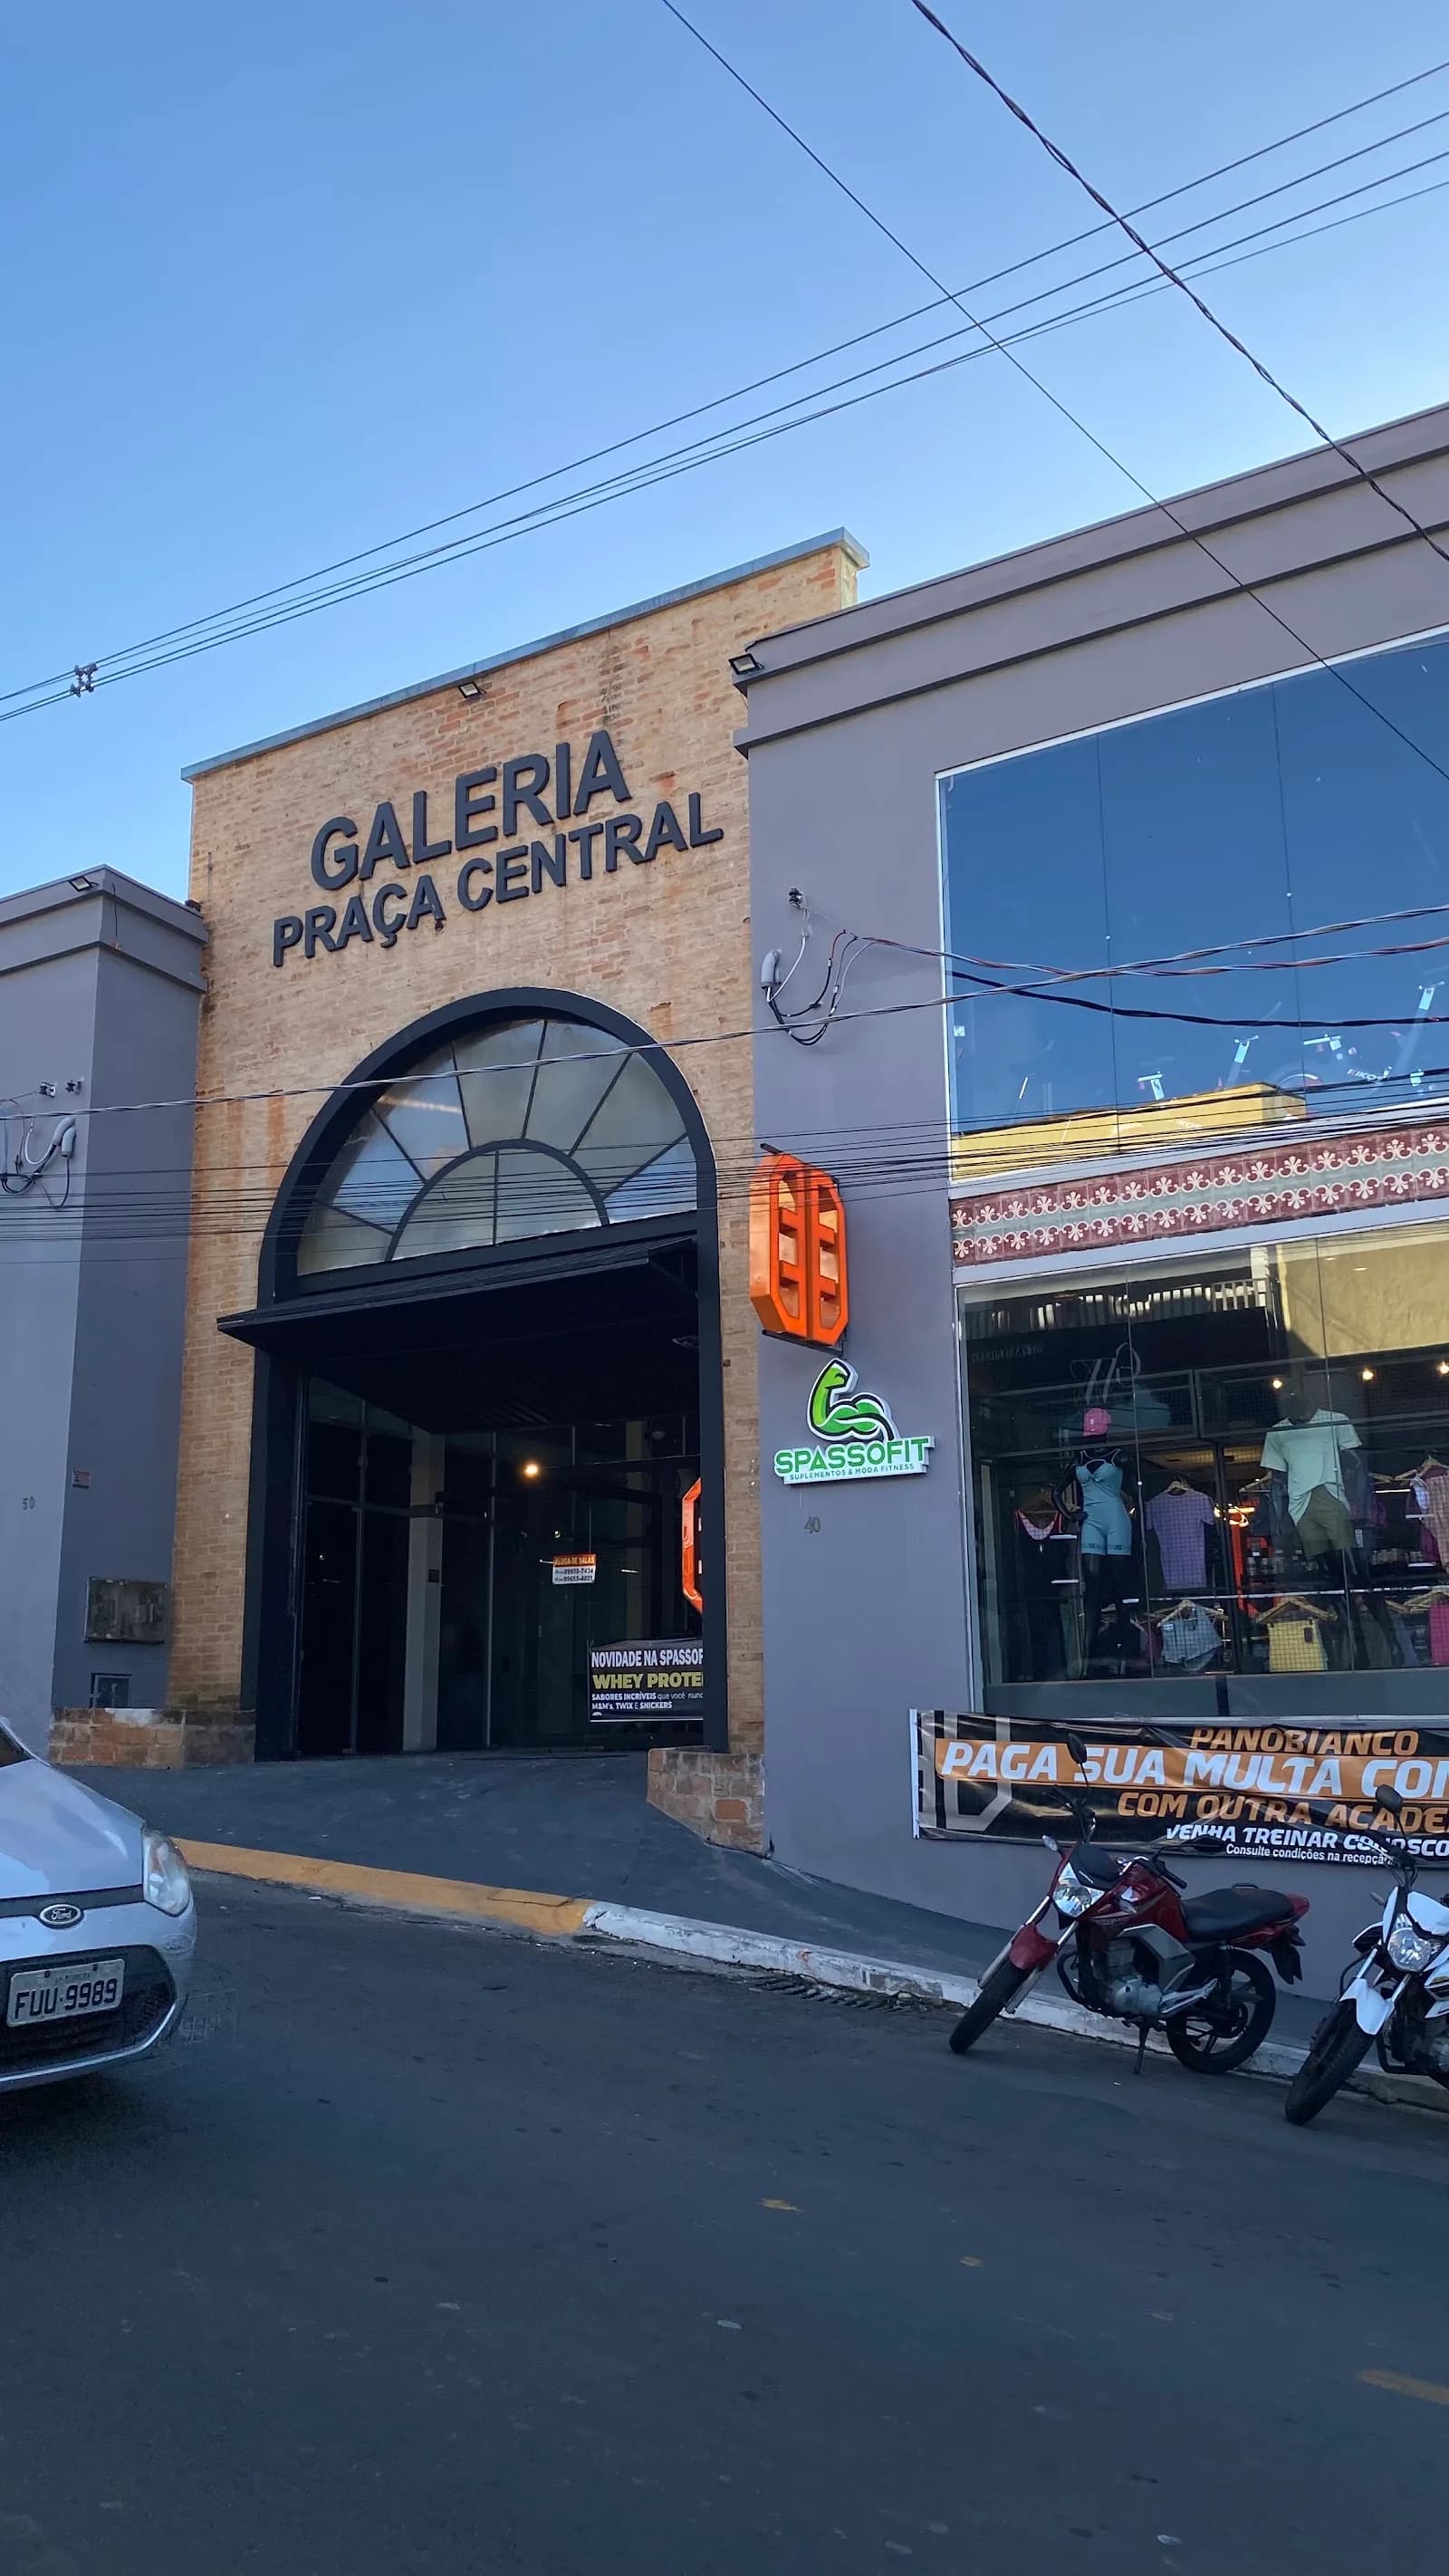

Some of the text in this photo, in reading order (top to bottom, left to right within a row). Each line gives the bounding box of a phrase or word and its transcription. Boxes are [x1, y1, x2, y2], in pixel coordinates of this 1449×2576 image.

[310, 729, 632, 890] GALERIA
[273, 792, 724, 967] PRAÇA CENTRAL
[775, 1437, 929, 1475] SPASSOFIT
[790, 1469, 846, 1481] SUPLEMENTOS
[855, 1466, 878, 1475] MODA
[881, 1463, 914, 1473] FITNESS
[22, 1496, 35, 1511] 50
[804, 1516, 820, 1533] 40
[591, 1650, 642, 1668] NOVIDADE
[644, 1649, 657, 1667] NA
[592, 1671, 703, 1689] WHEY PROTE
[591, 1692, 623, 1701] SABORES
[623, 1690, 657, 1701] INCRÍVEIS
[657, 1692, 670, 1701] que
[670, 1691, 686, 1700] você
[616, 1702, 634, 1710] TWIX
[635, 1702, 638, 1710] E
[639, 1701, 673, 1710] SNICKERS
[1189, 1725, 1420, 1756] PANOBIANCO
[939, 1741, 1058, 1781] PAGA
[1074, 1745, 1166, 1784] SUA
[1184, 1751, 1342, 1795] MULTA
[1117, 1792, 1449, 1833] COM OUTRA ACADE
[1166, 1823, 1236, 1842] VENHA
[1243, 1826, 1336, 1850] TREINAR
[1225, 1843, 1271, 1857] Consulte
[1272, 1846, 1325, 1861] condições
[1327, 1851, 1340, 1862] na
[52, 1908, 72, 1920] Ford
